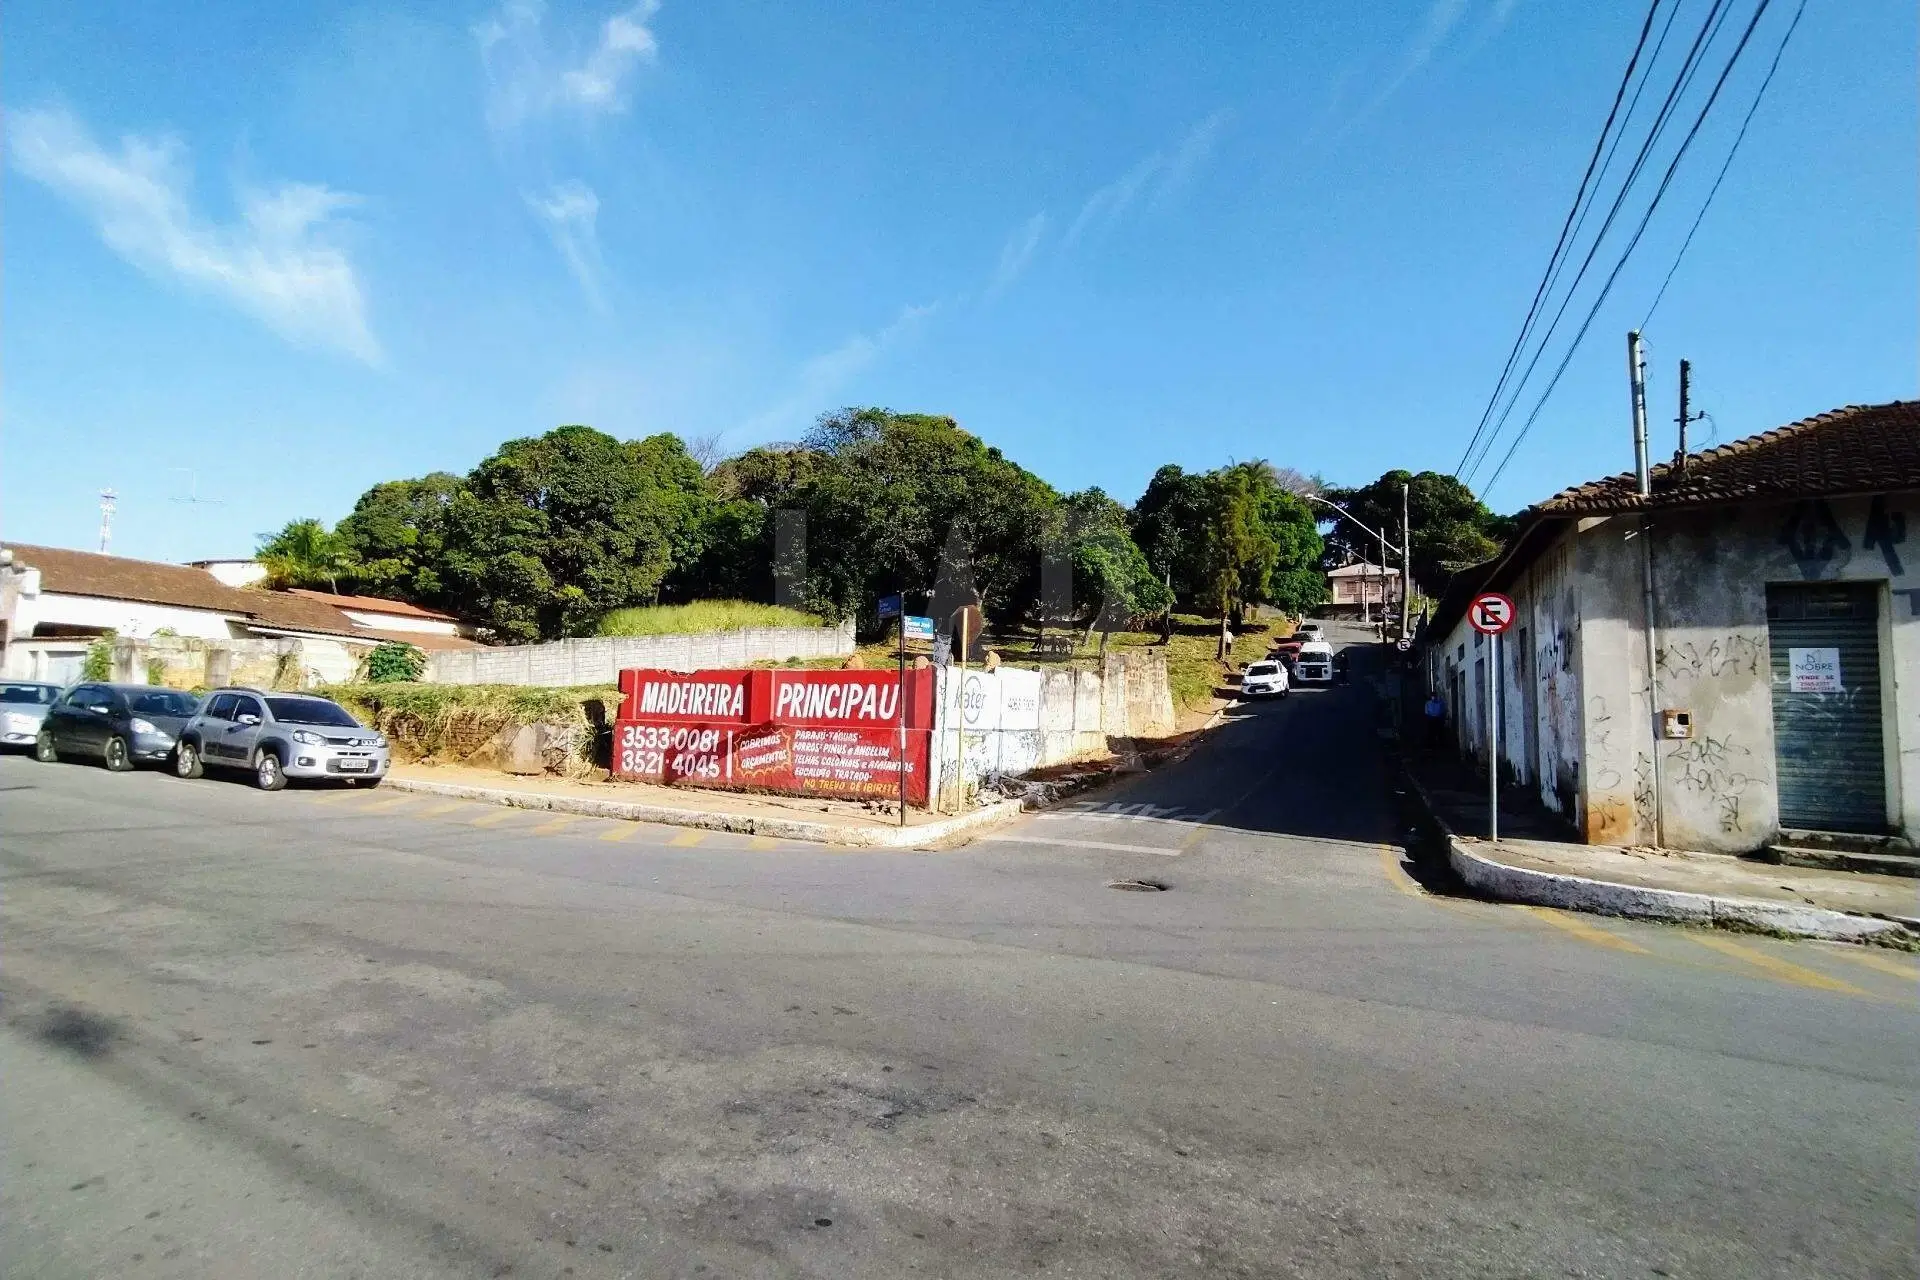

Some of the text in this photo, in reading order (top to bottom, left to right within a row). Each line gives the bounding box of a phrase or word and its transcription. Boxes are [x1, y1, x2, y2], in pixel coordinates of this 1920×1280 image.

[1795, 663, 1833, 671] NOBRE
[640, 681, 744, 717] MADEIREIRA
[740, 734, 782, 751] COBRIMOS
[794, 753, 820, 766] TELHAS
[803, 778, 816, 788] NO
[849, 781, 861, 792] DE
